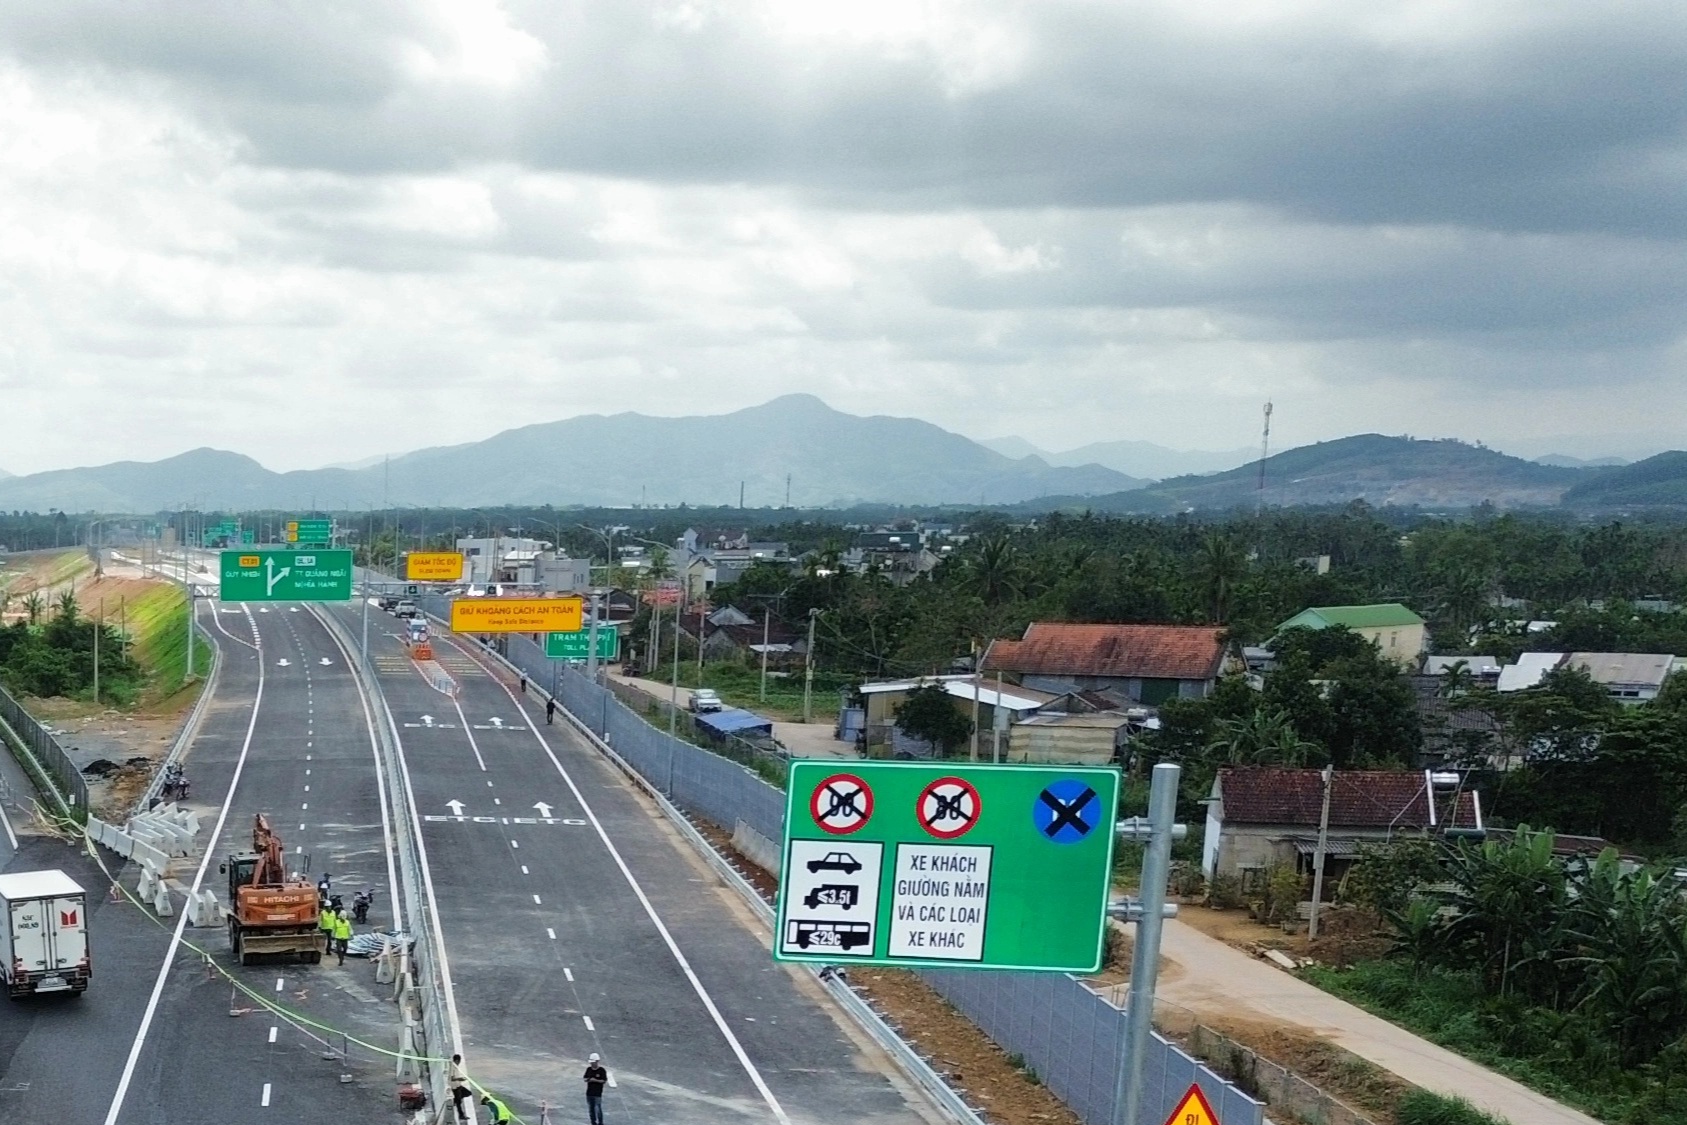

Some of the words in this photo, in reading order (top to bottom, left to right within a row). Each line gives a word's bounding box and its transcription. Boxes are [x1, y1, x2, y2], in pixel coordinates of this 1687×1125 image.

[460, 605, 474, 614] GIỮ
[476, 605, 511, 615] KHOẢNG
[513, 605, 535, 614] CÁCH
[537, 606, 549, 614] AN
[552, 604, 574, 614] TOÀN
[910, 855, 926, 870] XE
[932, 853, 977, 872] KHÁCH
[898, 876, 950, 896] GIƯỜNG
[954, 875, 985, 898] NẰM
[898, 901, 915, 921] VÀ
[920, 903, 945, 922] CÁC
[950, 907, 981, 926] LOẠI
[908, 930, 925, 946] XE
[929, 929, 965, 948] KHÁC
[1185, 1113, 1199, 1125] ĐI
